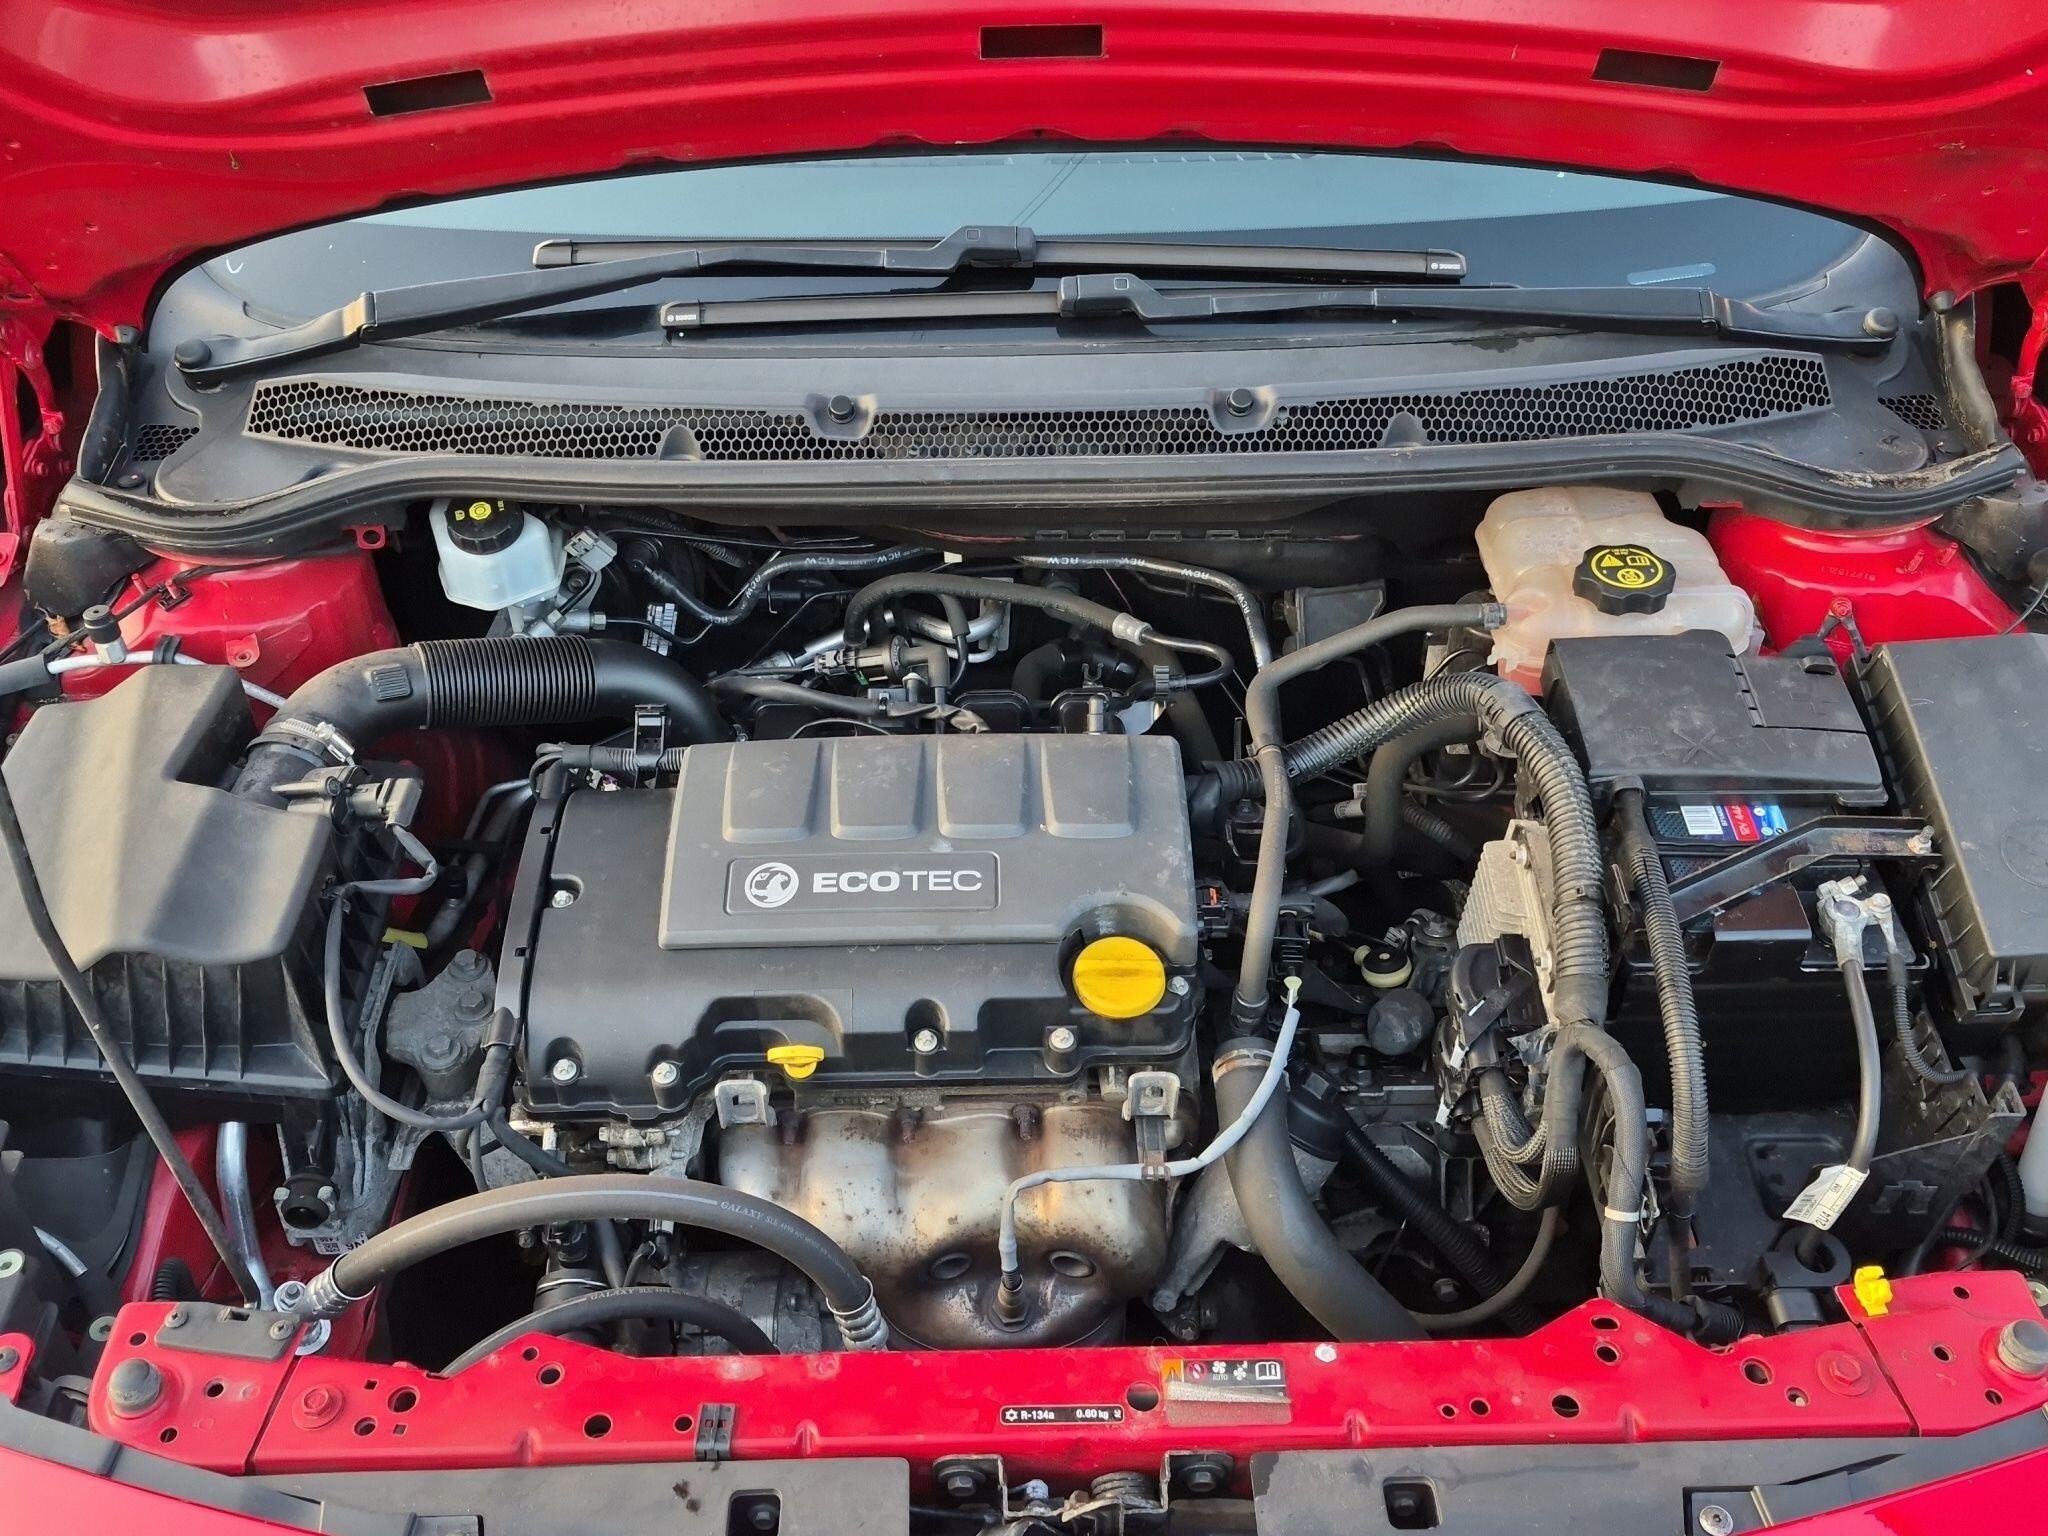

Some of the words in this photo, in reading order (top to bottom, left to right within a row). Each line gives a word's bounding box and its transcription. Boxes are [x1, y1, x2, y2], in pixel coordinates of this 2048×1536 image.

[813, 870, 982, 893] ECOTEC
[720, 1201, 763, 1220] GALAXY
[1815, 1211, 1832, 1227] 2U4
[1020, 1410, 1055, 1421] R-134a
[1075, 1408, 1097, 1419] 0.60
[1098, 1409, 1109, 1420] kg
